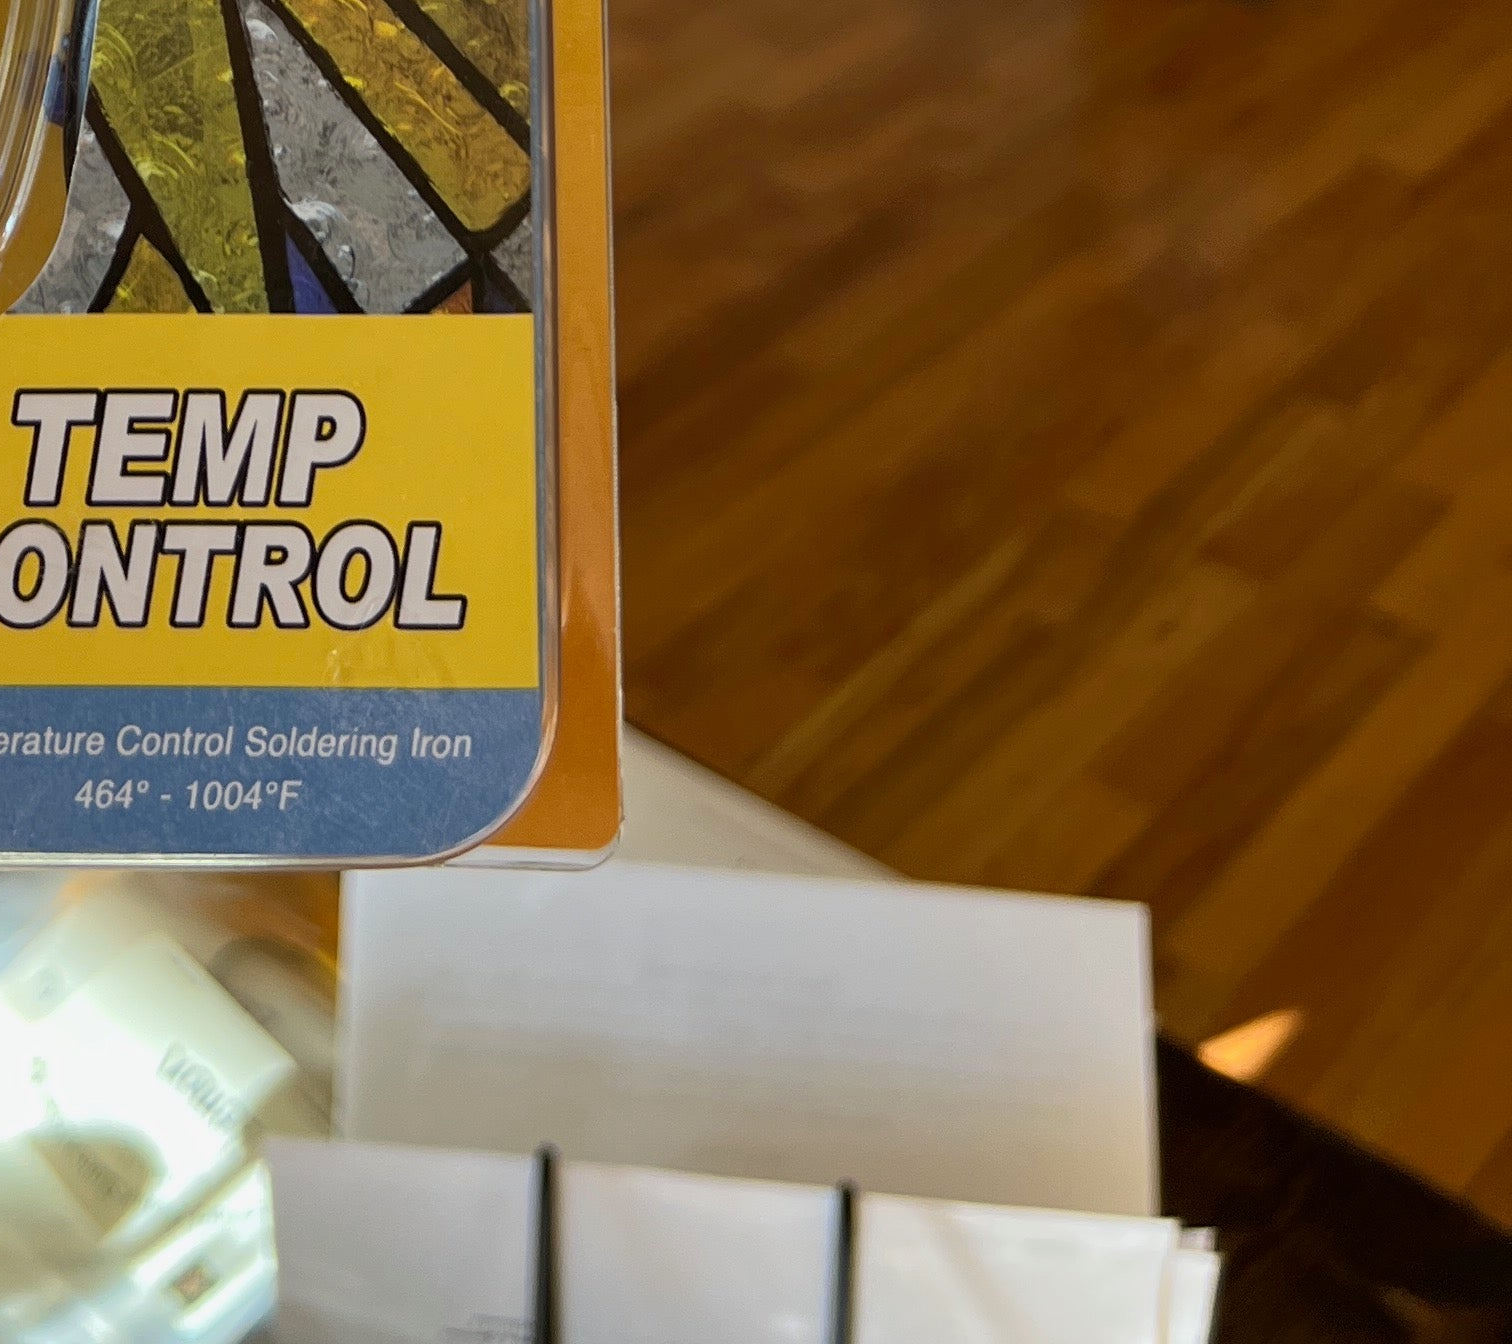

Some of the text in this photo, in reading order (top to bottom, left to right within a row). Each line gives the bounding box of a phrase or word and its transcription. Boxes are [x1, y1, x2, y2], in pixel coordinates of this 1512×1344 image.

[12, 387, 367, 508] TEMP
[116, 723, 233, 757] Control
[245, 726, 398, 765] Soldering
[410, 728, 472, 758] Iron
